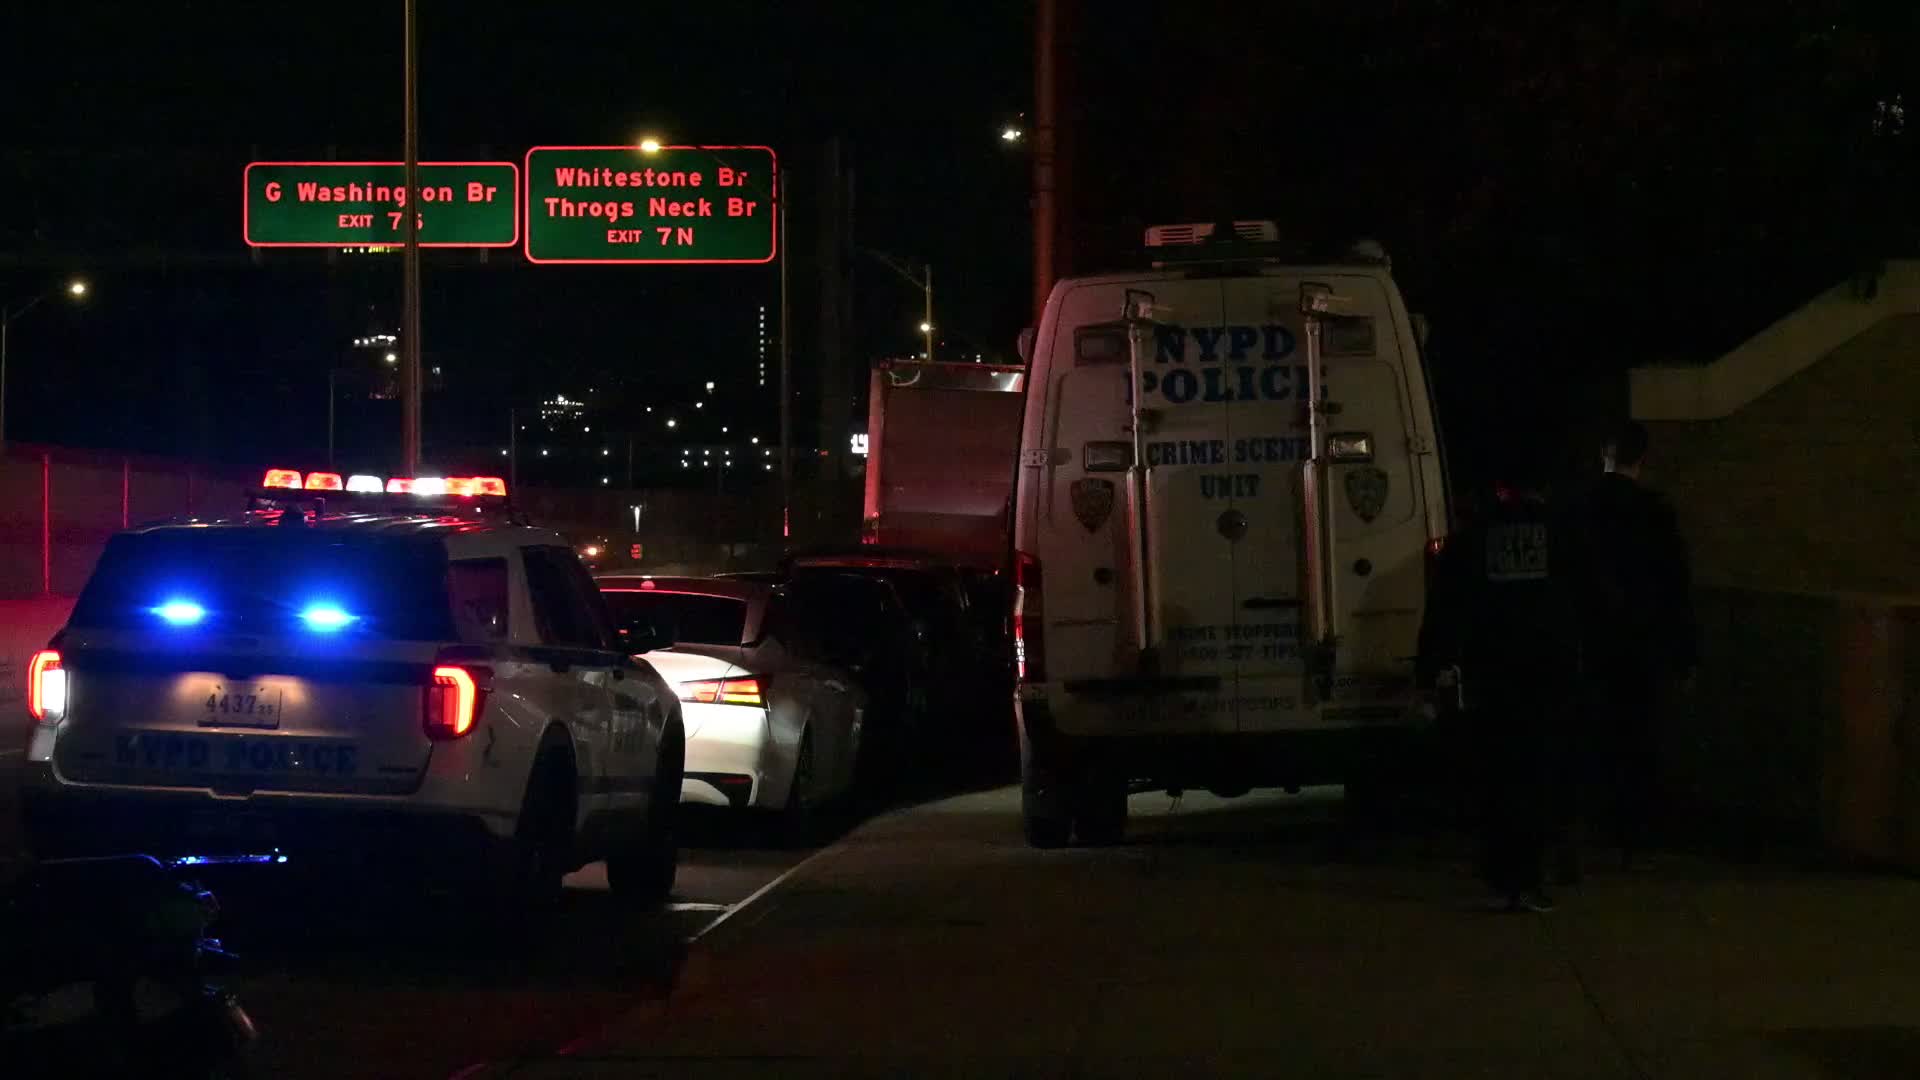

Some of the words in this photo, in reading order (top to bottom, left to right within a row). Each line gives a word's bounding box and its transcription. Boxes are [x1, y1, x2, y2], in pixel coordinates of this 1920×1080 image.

[555, 167, 702, 187] Whitestone
[718, 167, 748, 187] Br
[265, 182, 281, 202] G
[297, 182, 453, 207] Washingon
[467, 182, 496, 202] Br
[338, 214, 373, 228] EXIT
[544, 198, 634, 222] Throgs
[649, 198, 712, 217] Neck
[728, 198, 756, 217] Br
[607, 230, 642, 243] EXIT
[656, 227, 693, 245] 7N
[1154, 325, 1296, 363] NYPD
[1147, 439, 1224, 465] CRIME
[1200, 474, 1260, 499] UNIT
[206, 693, 257, 713] 4437
